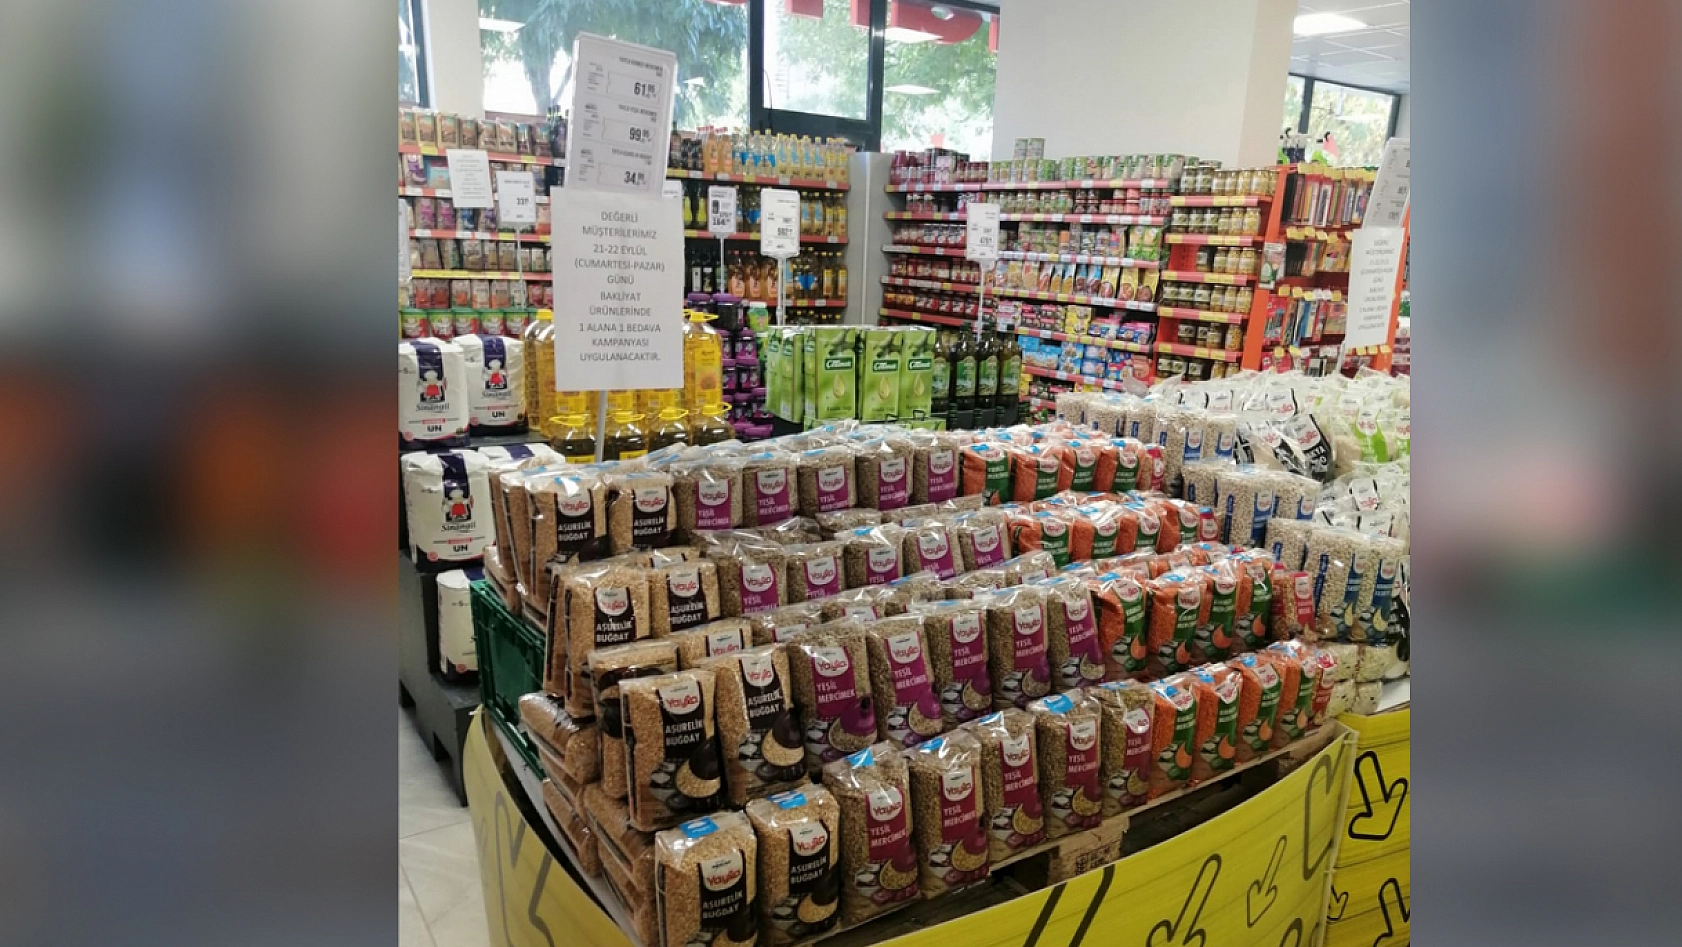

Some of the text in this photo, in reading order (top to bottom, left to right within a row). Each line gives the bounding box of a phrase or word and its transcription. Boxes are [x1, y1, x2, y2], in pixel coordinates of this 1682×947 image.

[601, 211, 638, 222] DEĞERLİ
[582, 226, 657, 240] MÜŞTERİLERİMİZ
[594, 244, 647, 256] 21-22 EYLÜL
[607, 274, 634, 285] GÜNÜ
[590, 306, 651, 317] ÜRÜNLERİNDE
[580, 323, 661, 333] 1 ALANA 1 BEDAVA
[592, 338, 648, 347] KAMPANYASI
[580, 352, 660, 362] UYGULANACAKTIR.
[492, 410, 504, 418] UN
[427, 424, 442, 432] UN
[453, 544, 468, 552] UN
